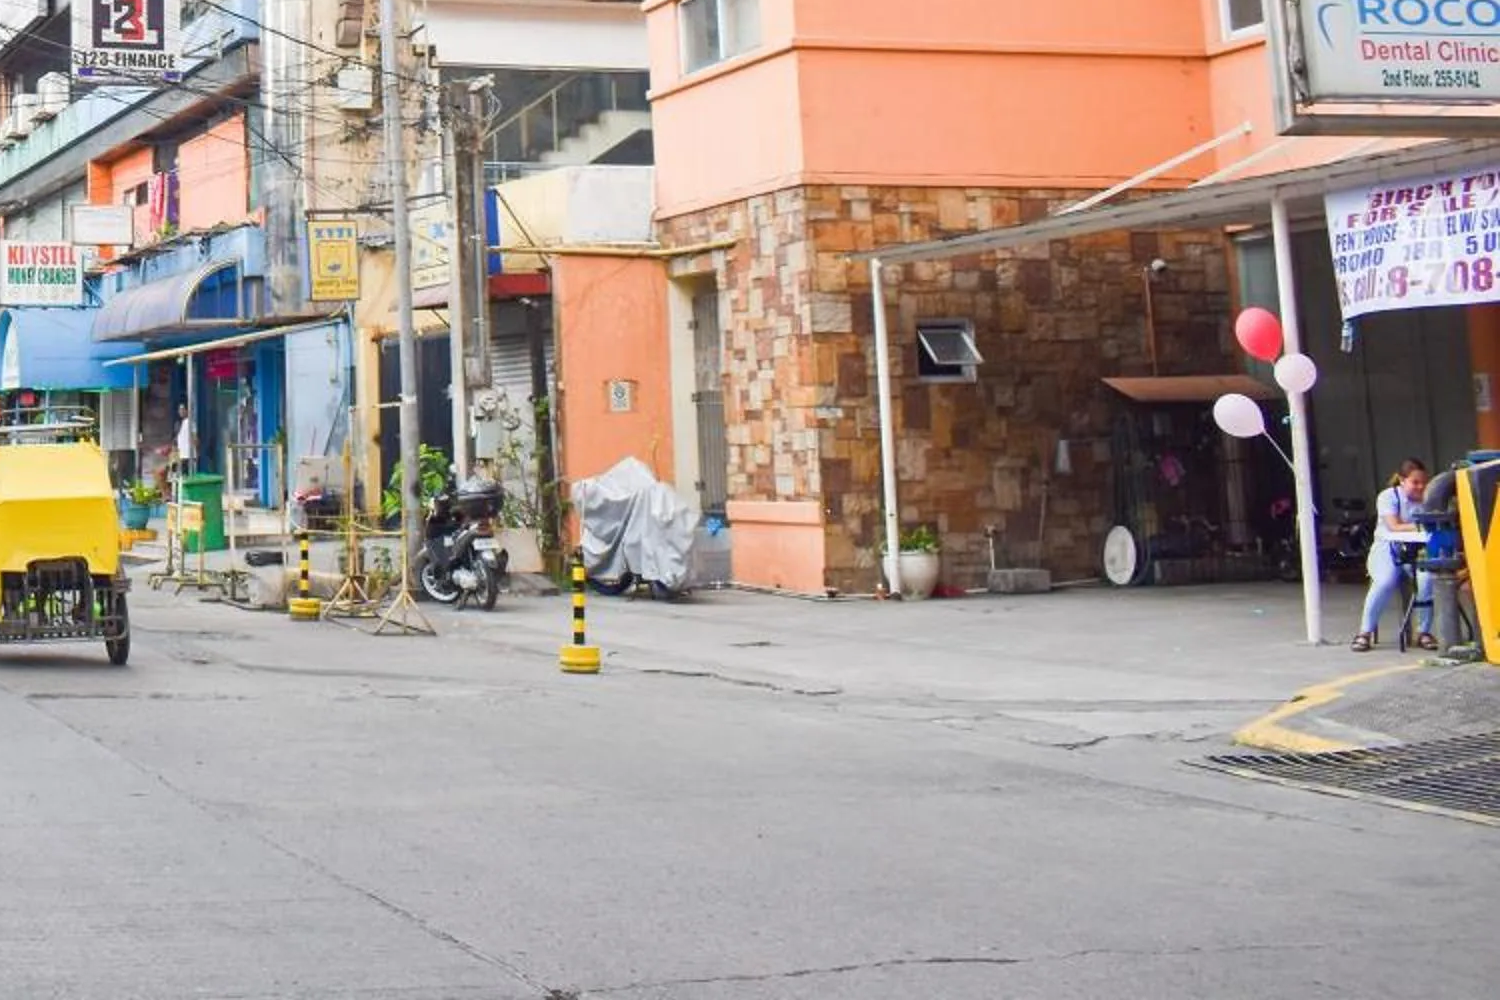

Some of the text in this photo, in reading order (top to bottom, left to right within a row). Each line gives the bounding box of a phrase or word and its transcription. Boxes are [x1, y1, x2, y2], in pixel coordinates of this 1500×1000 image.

[1361, 40, 1500, 63] Dental Clinic
[1381, 68, 1402, 87] 2nd
[1461, 172, 1500, 193] TO
